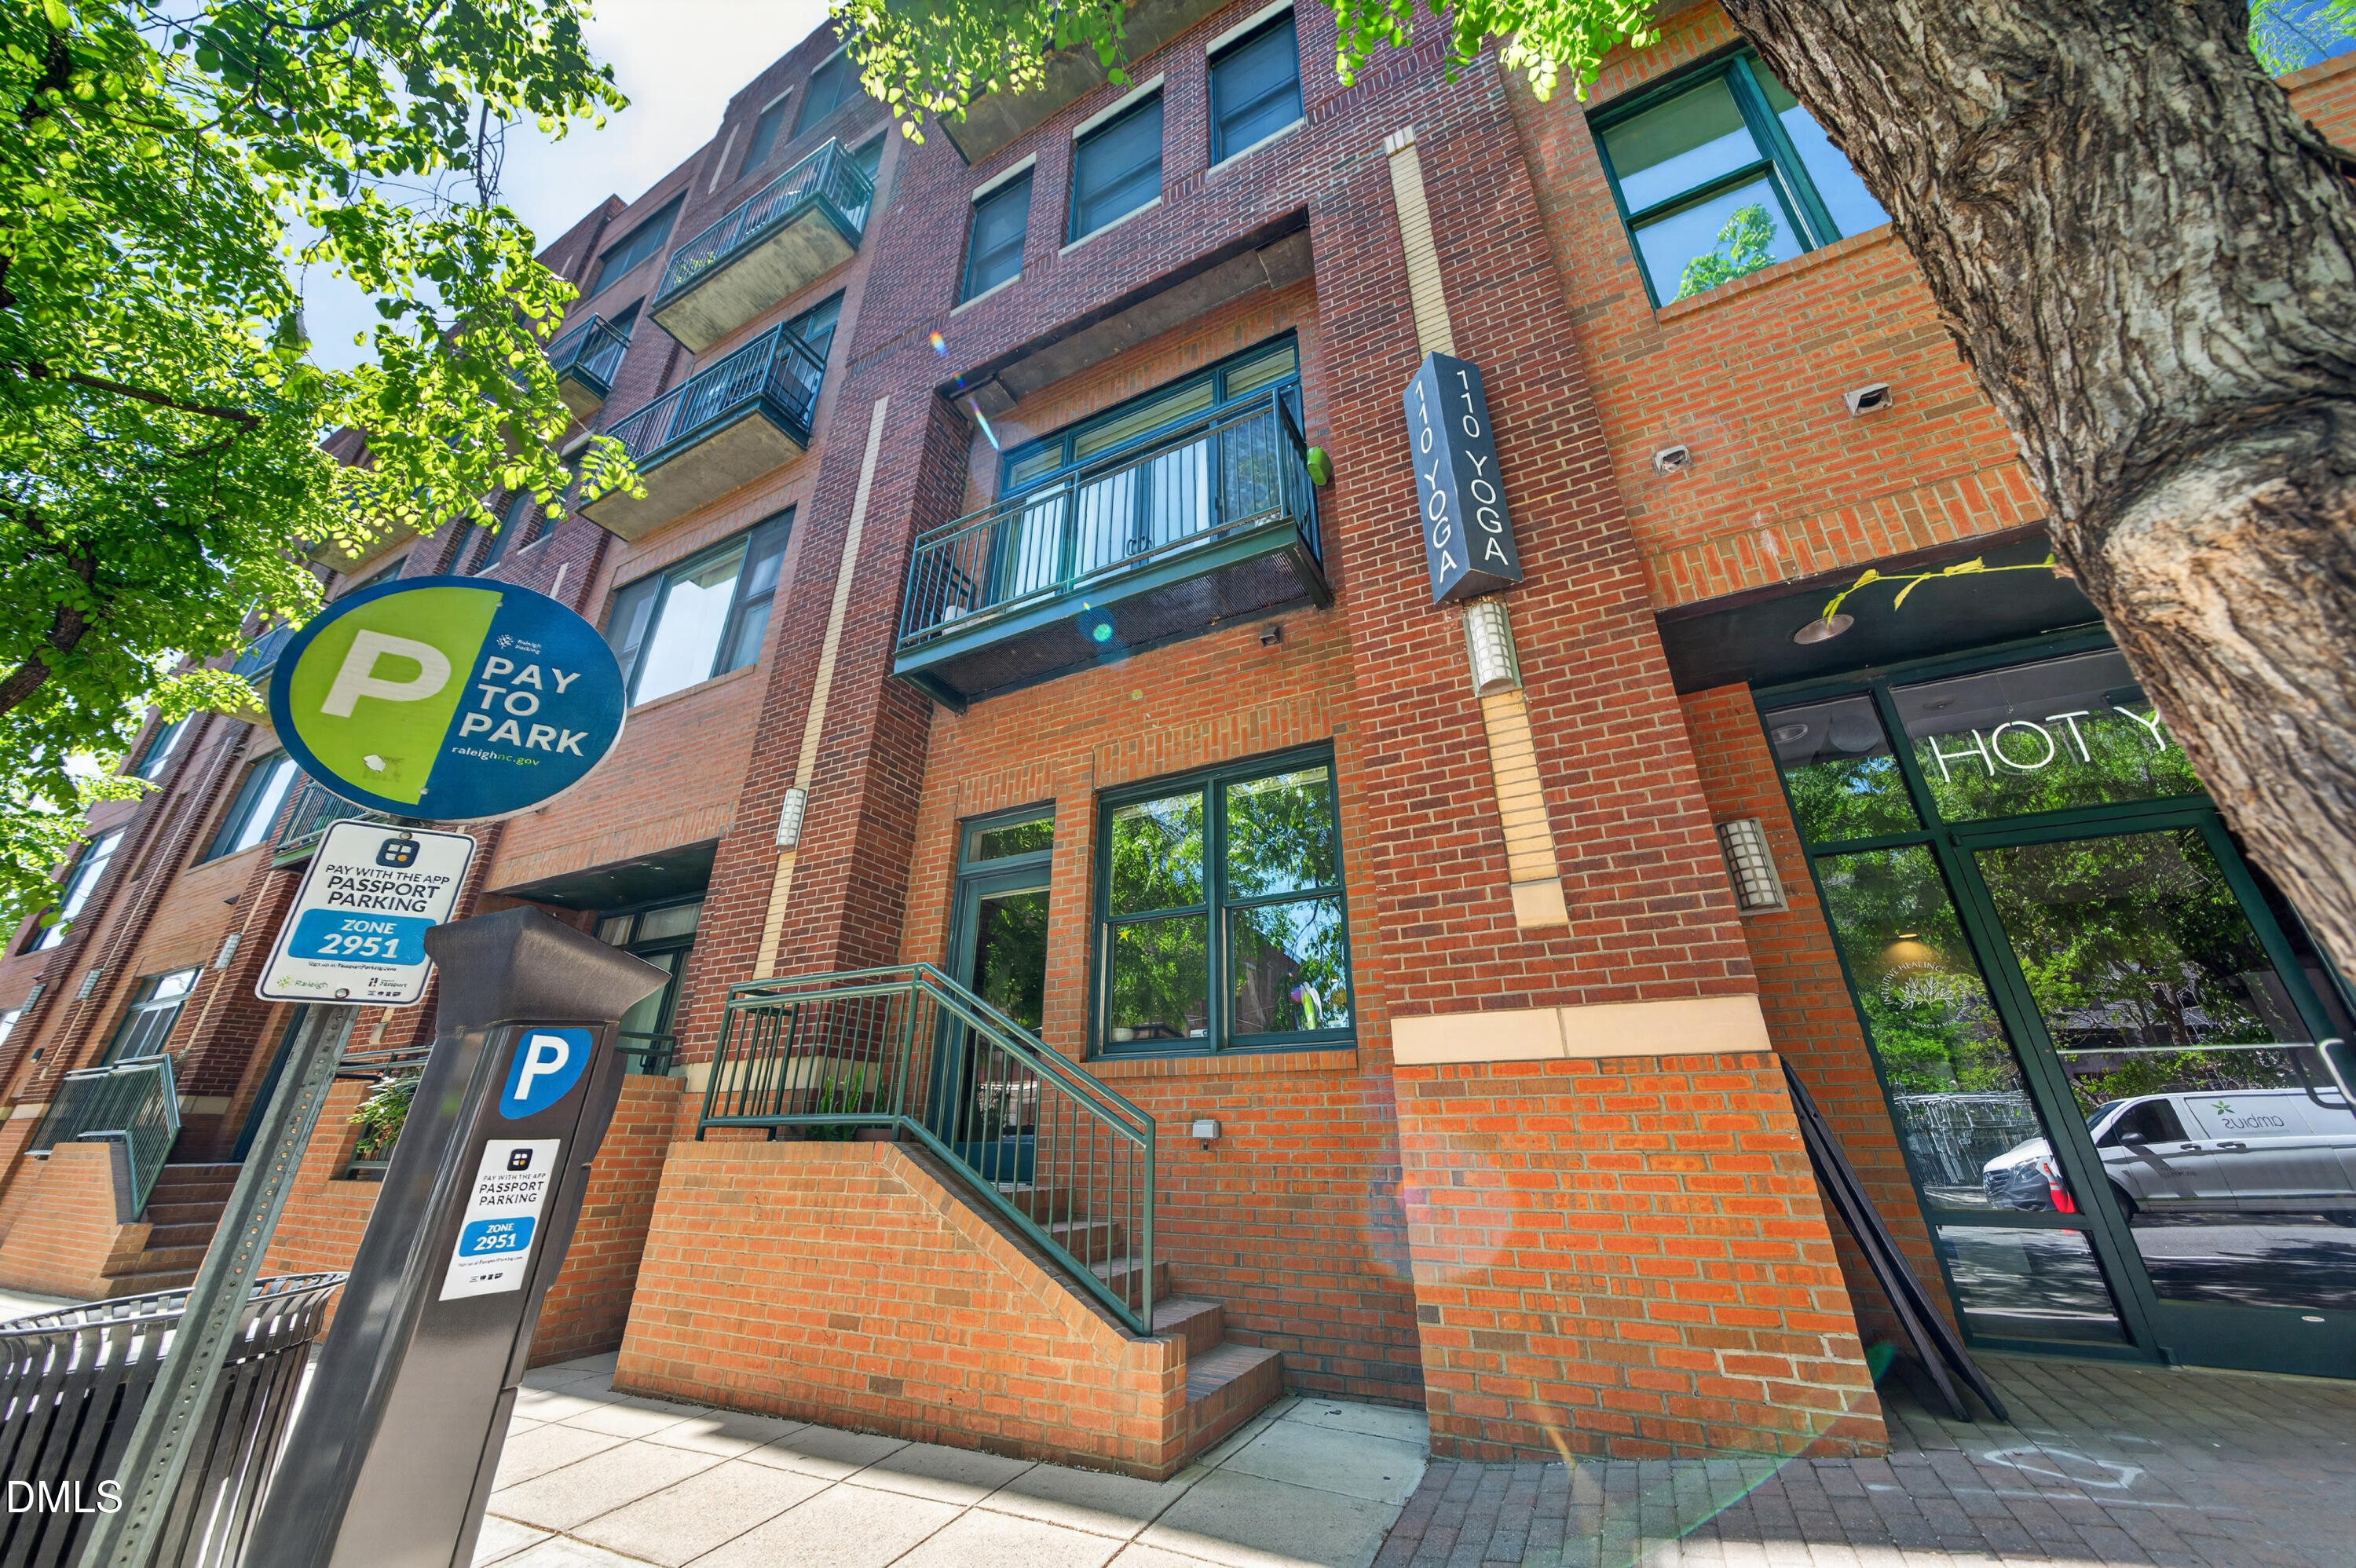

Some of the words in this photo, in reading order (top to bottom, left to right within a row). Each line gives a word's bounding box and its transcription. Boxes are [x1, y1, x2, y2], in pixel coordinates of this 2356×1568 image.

[1457, 370, 1480, 438] 110
[1415, 380, 1432, 454] 110
[1424, 459, 1458, 583] YOGA
[1465, 450, 1509, 566] YOGA
[320, 629, 452, 718] P
[481, 656, 581, 695] PAY
[477, 683, 539, 717] TO
[458, 712, 589, 757] PARK
[452, 746, 540, 766] raleighnc.gov
[1928, 711, 2091, 784] HOT
[325, 864, 353, 875] PAY
[356, 868, 393, 879] WITH
[397, 872, 423, 883] THE
[423, 875, 451, 885] APP
[327, 875, 441, 898] PASSPORT
[327, 891, 428, 912] PARKING
[340, 919, 397, 934] ZONE
[317, 934, 400, 959] 2951
[1897, 961, 1944, 974] HEALING
[514, 1035, 569, 1100] P
[479, 1181, 544, 1193] PASSPORT
[479, 1193, 538, 1206] PARKING
[487, 1223, 514, 1234] ZONE
[473, 1233, 517, 1251] 2951
